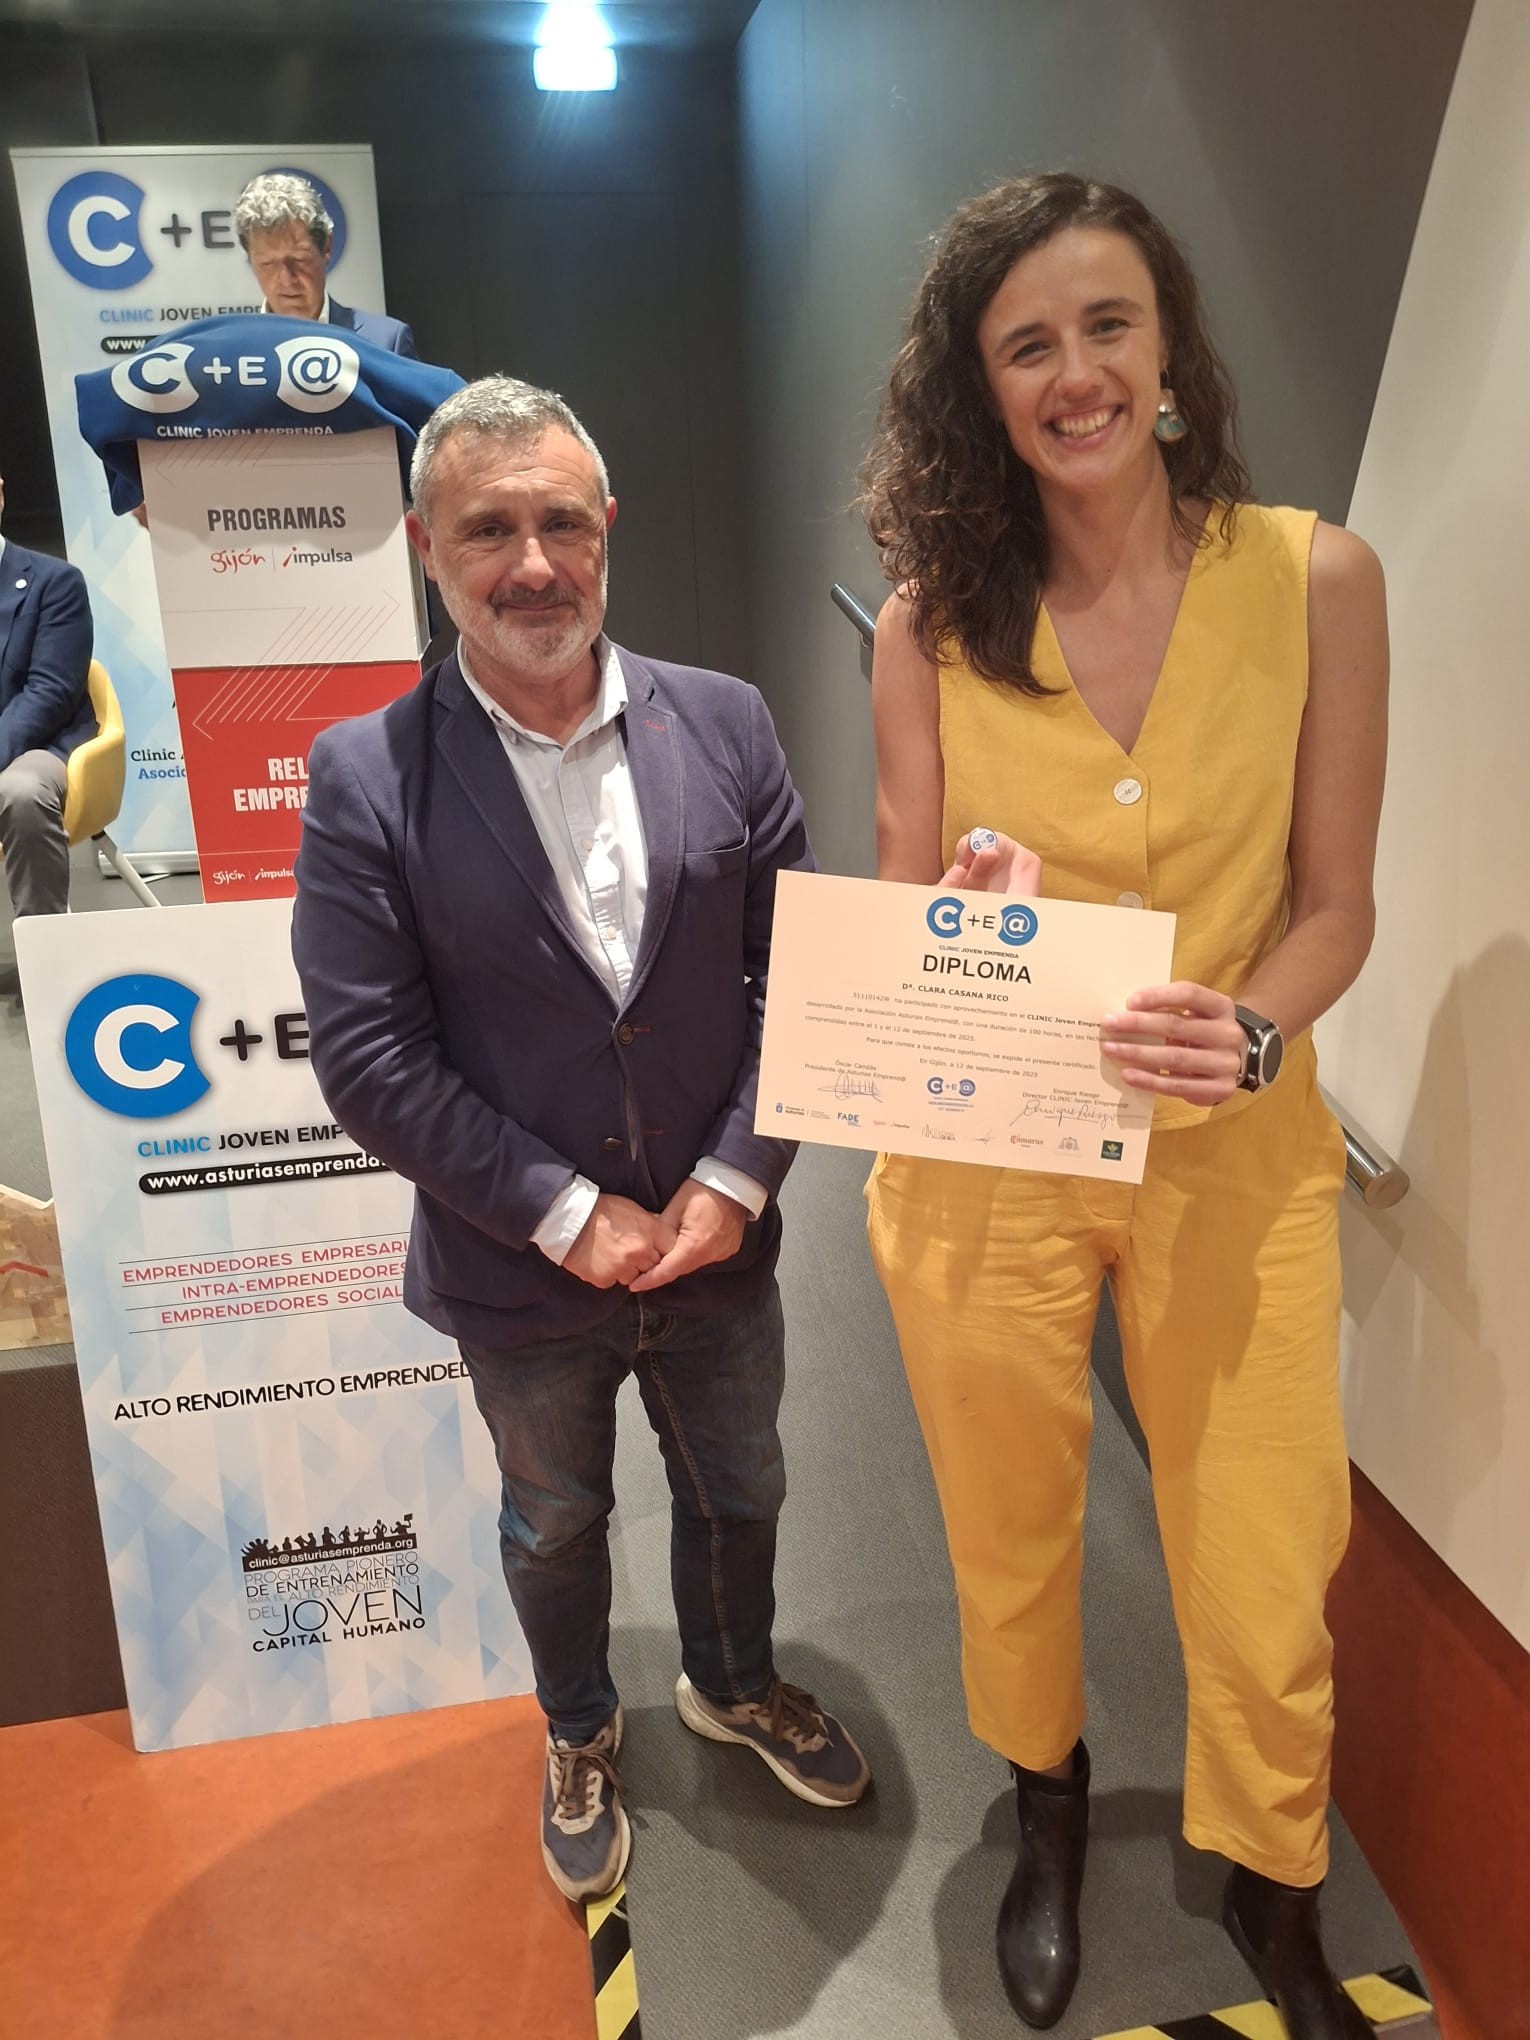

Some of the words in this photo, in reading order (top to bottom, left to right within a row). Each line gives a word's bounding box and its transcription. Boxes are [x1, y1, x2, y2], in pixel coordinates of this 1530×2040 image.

[100, 308, 153, 323] CLINIC
[160, 306, 212, 321] JOVEN
[156, 426, 203, 439] CLINIC
[208, 506, 346, 531] PROGRAMAS
[210, 549, 266, 574] gijón
[282, 546, 353, 567] impulsa
[131, 748, 176, 761] Clinic
[267, 757, 309, 781] REL
[212, 869, 246, 885] gijón
[984, 950, 1019, 959] EMPRENDA
[922, 954, 1032, 984] DIPLOMA
[918, 985, 946, 995] CLARA
[948, 988, 984, 999] CASANA
[986, 993, 1009, 1002] RICO
[904, 998, 938, 1009] participado
[953, 1005, 1008, 1017] aprovechamiento
[1027, 1013, 1053, 1022] CLINIC
[1055, 1017, 1076, 1025] Joven
[912, 1028, 947, 1039] septiembre
[990, 1023, 1017, 1033] duración
[866, 1036, 880, 1044] Para
[1032, 1058, 1061, 1067] presente
[805, 1063, 836, 1073] Presidente
[847, 1069, 871, 1078] Asturias
[975, 1065, 1011, 1075] septiembre
[1022, 1092, 1047, 1100] Director
[1049, 1095, 1072, 1103] CLINIC
[1053, 1088, 1077, 1097] Enrique
[1079, 1091, 1100, 1099] Riesgo
[837, 1112, 859, 1122] FADE
[138, 1136, 211, 1158] CLINIC
[218, 1129, 290, 1150] JOVEN
[297, 1124, 344, 1142] EMP
[122, 1253, 293, 1283] EMPRENDEDORES
[301, 1240, 408, 1264] EMPRESARI
[161, 1293, 329, 1325] EMPRENDEDORES
[337, 1284, 403, 1305] SOCIAL
[114, 1398, 171, 1420] ALTO
[176, 1378, 336, 1413] RENDIMIENTO
[249, 1537, 414, 1569] clinic@asturiasemprenda.org
[244, 1563, 340, 1585] PROGRAMA
[347, 1551, 418, 1571] PIONERO
[246, 1585, 269, 1598] DE
[276, 1563, 419, 1594] ENTRENAMIENTO
[328, 1575, 420, 1596] RENDIMIENTO
[248, 1605, 281, 1621] DEL
[263, 1585, 422, 1637] JOVEN
[252, 1631, 332, 1652] CAPITAL
[343, 1617, 426, 1640] HUMANO
